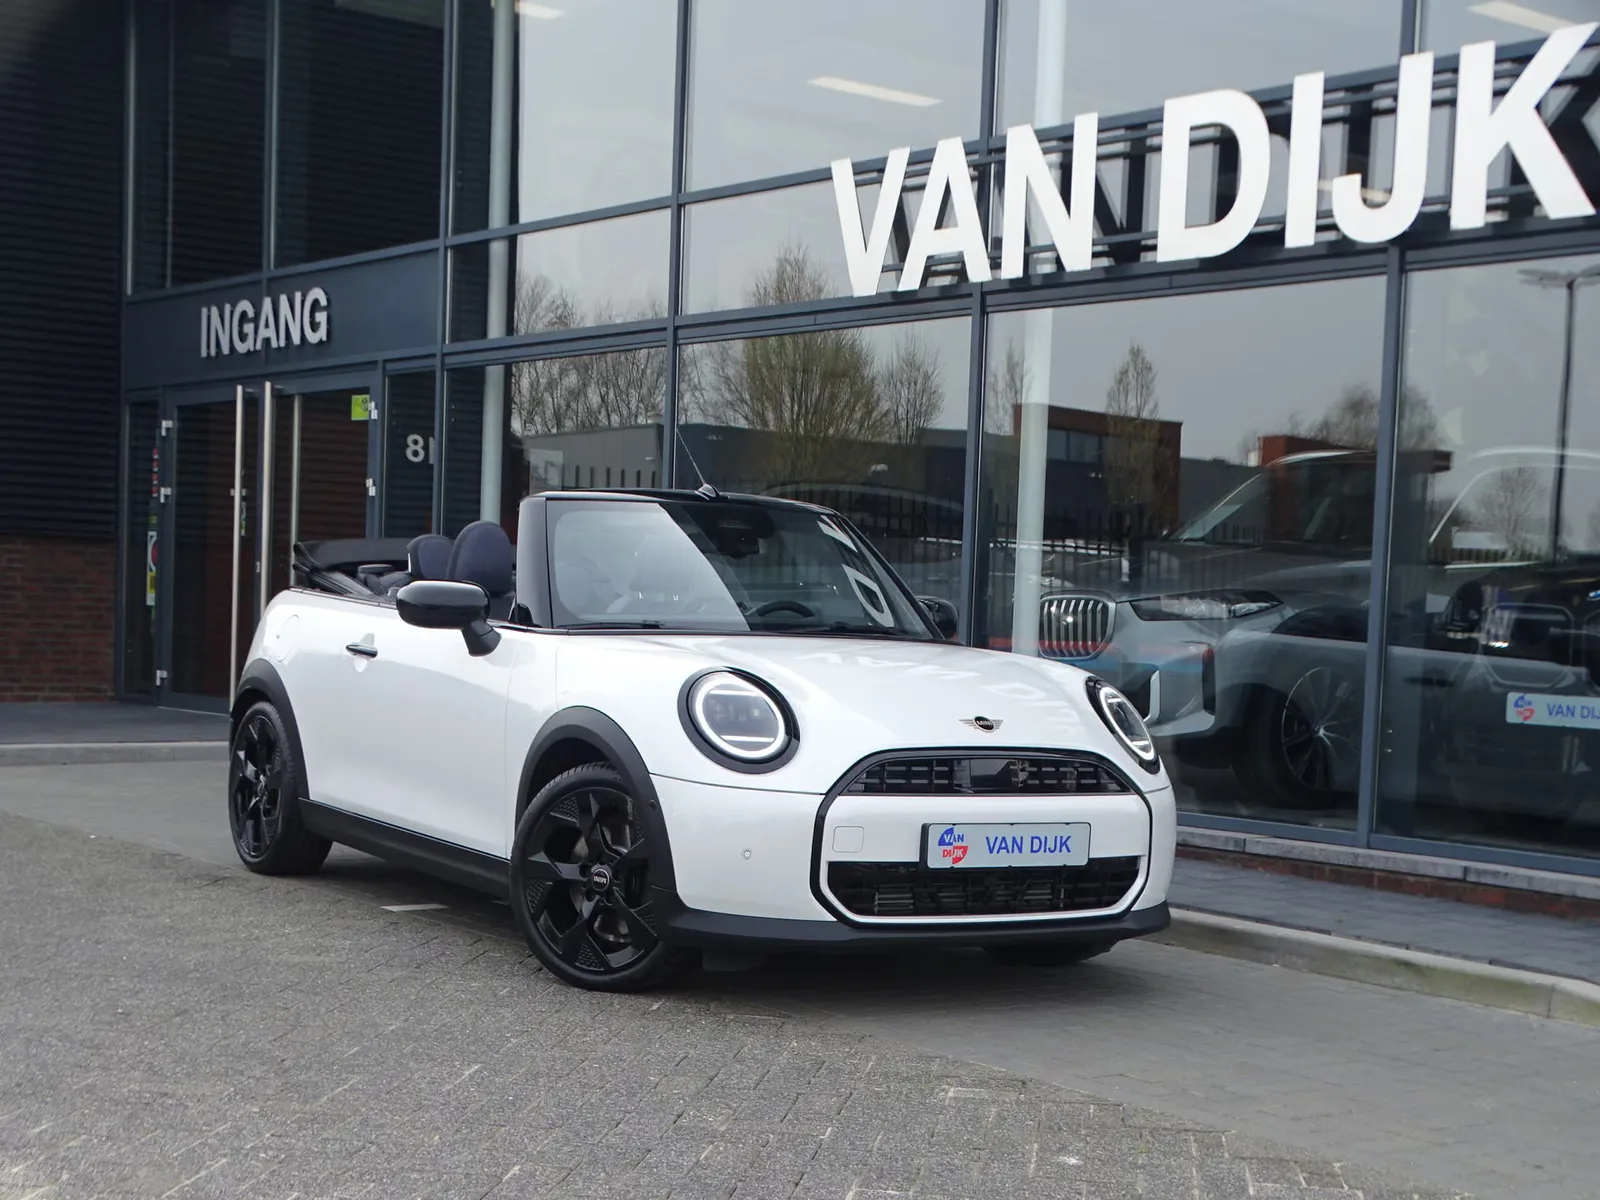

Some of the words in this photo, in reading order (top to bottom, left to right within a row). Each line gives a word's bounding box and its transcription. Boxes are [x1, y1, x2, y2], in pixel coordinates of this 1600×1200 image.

[831, 112, 1098, 297] VAN
[1157, 22, 1600, 262] DIJK
[201, 286, 328, 358] INGANG
[1546, 702, 1576, 718] VAN
[943, 833, 965, 844] VAN
[985, 835, 1024, 855] VAN
[1029, 835, 1072, 854] DIJK
[942, 848, 964, 858] DIJK
